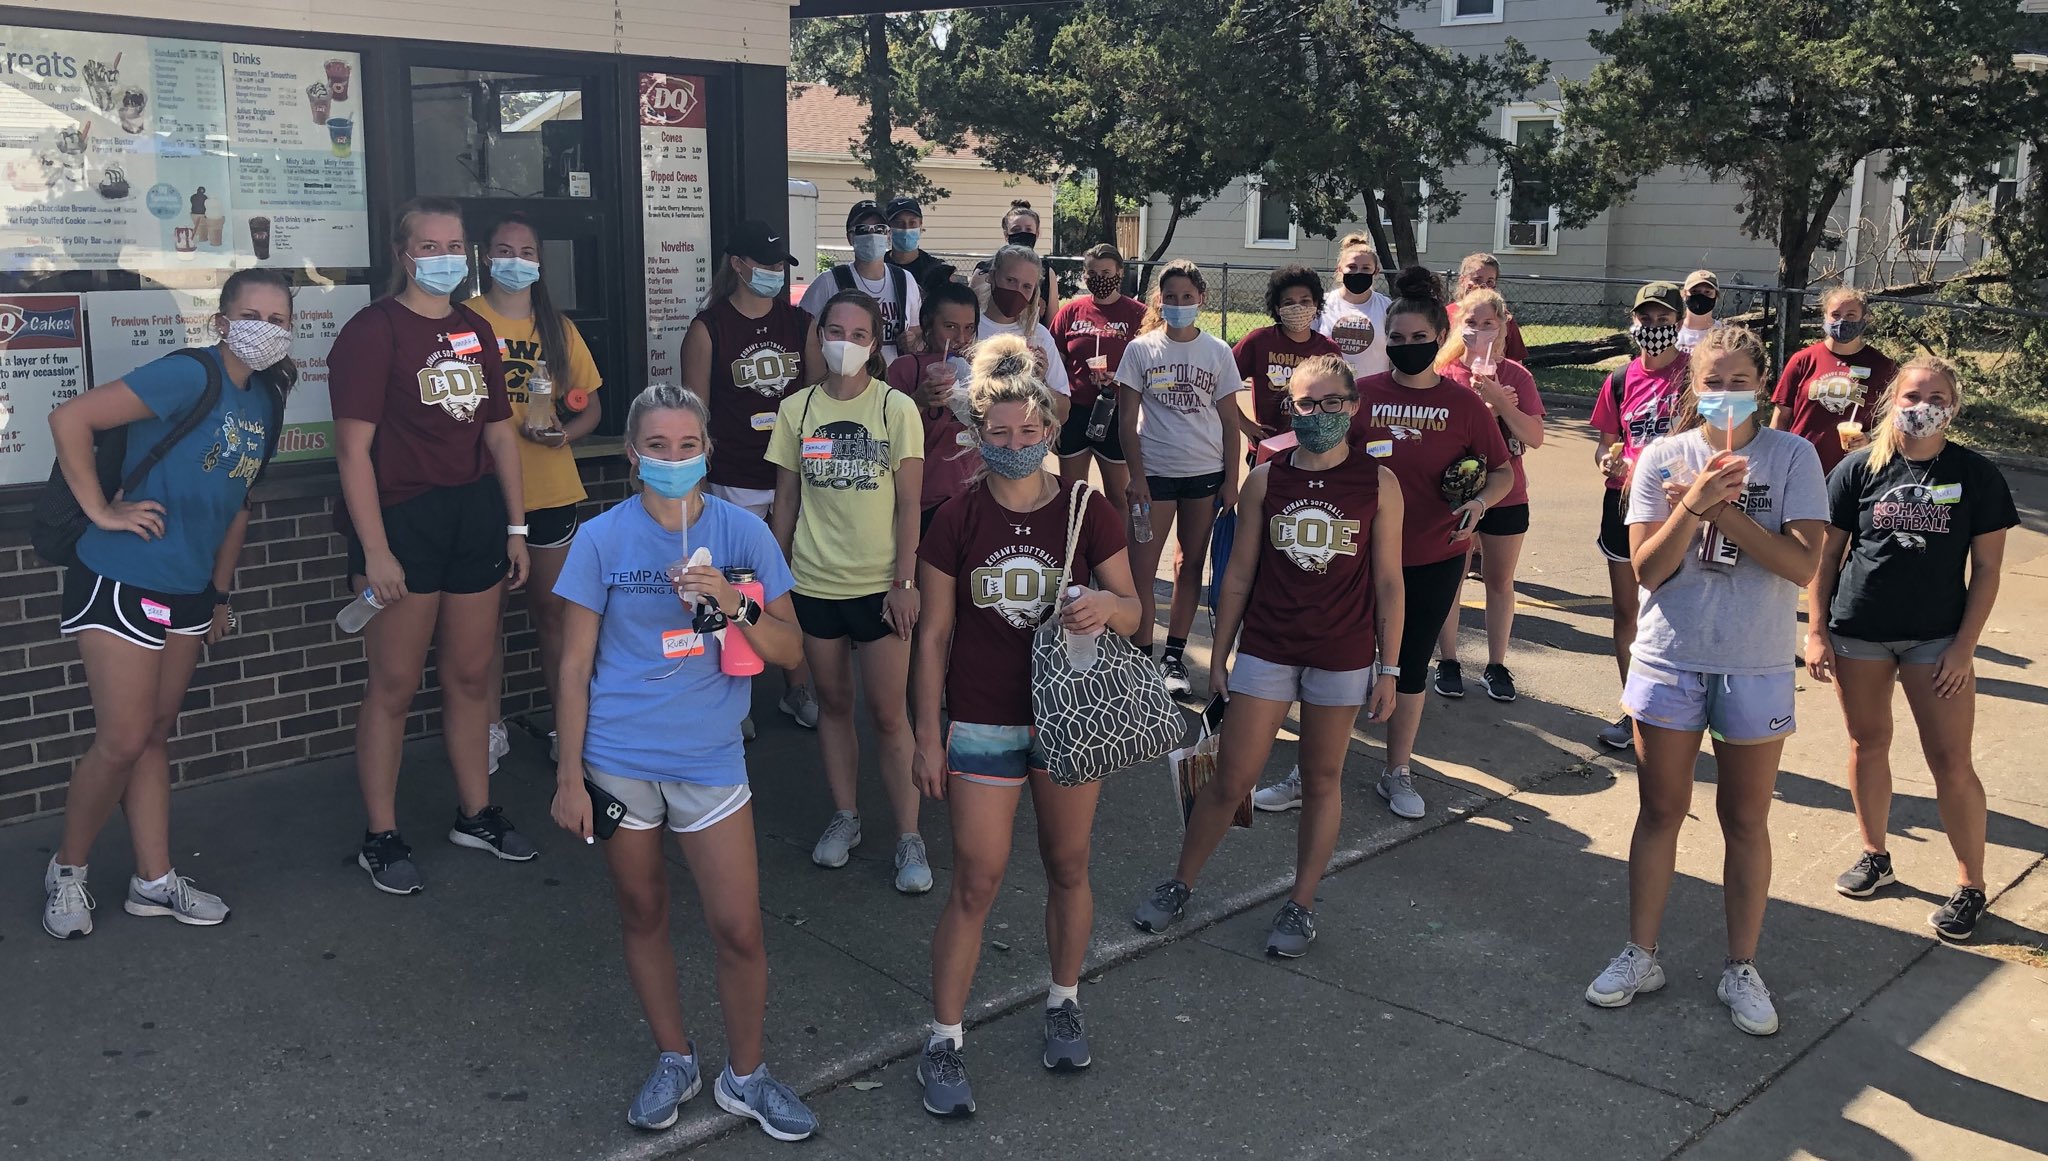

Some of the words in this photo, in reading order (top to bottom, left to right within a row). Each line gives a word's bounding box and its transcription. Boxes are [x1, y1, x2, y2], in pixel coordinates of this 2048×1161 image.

[232, 51, 261, 66] Drinks
[653, 87, 688, 113] DQ
[661, 131, 683, 143] Cones
[650, 169, 675, 184] Dipped
[676, 171, 698, 183] Cones
[661, 240, 695, 252] Novelties
[0, 312, 16, 335] Q
[30, 315, 71, 331] Cakes
[111, 315, 150, 327] Premium
[152, 314, 173, 326] Fruit
[300, 309, 334, 322] Originals
[133, 329, 147, 337] 3.19
[159, 329, 174, 337] 3.99
[1335, 337, 1369, 347] SOFTBALL
[1341, 344, 1361, 352] CAMP
[5, 358, 11, 367] a
[13, 355, 38, 368] layer
[40, 353, 50, 365] of
[53, 353, 69, 364] fun
[309, 357, 327, 368] Cola
[650, 349, 666, 361] Pint
[12, 369, 30, 380] any
[651, 366, 673, 377] Quart
[731, 352, 801, 389] COE
[1267, 364, 1294, 378] PRO
[61, 379, 77, 387] 2.89
[417, 364, 490, 406] COE
[1370, 404, 1450, 432] KOHAWKS
[278, 428, 326, 452] ulius
[805, 457, 880, 478] SOFTBALL
[1282, 498, 1308, 516] KOHAWK
[1310, 499, 1345, 520] SOFTBALL
[1872, 501, 1952, 520] KOHAWK
[1872, 515, 1950, 534] SOFTBALL
[1269, 513, 1361, 557] COE
[985, 545, 1017, 567] KOHAWK
[1018, 545, 1059, 568] SOFTBALL
[620, 586, 666, 596] OVIDING
[665, 637, 689, 650] RUBY
